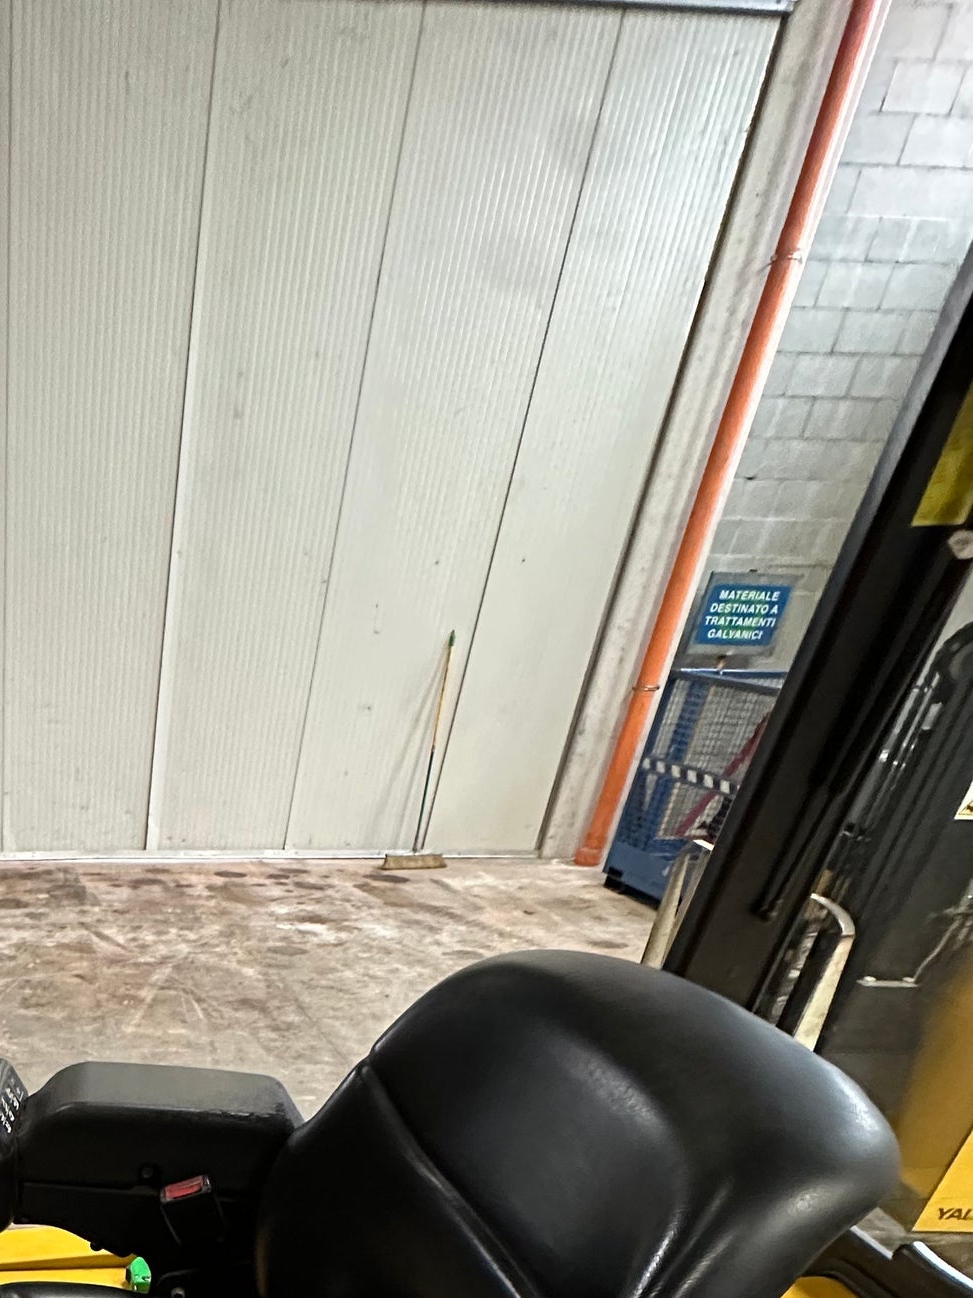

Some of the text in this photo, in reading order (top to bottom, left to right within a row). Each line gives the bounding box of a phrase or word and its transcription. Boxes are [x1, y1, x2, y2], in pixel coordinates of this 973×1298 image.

[719, 590, 780, 601] MATERIALE
[710, 602, 779, 614] DESTINATO A
[705, 616, 776, 628] TRATTAMENTI
[707, 629, 763, 640] GALVANICI
